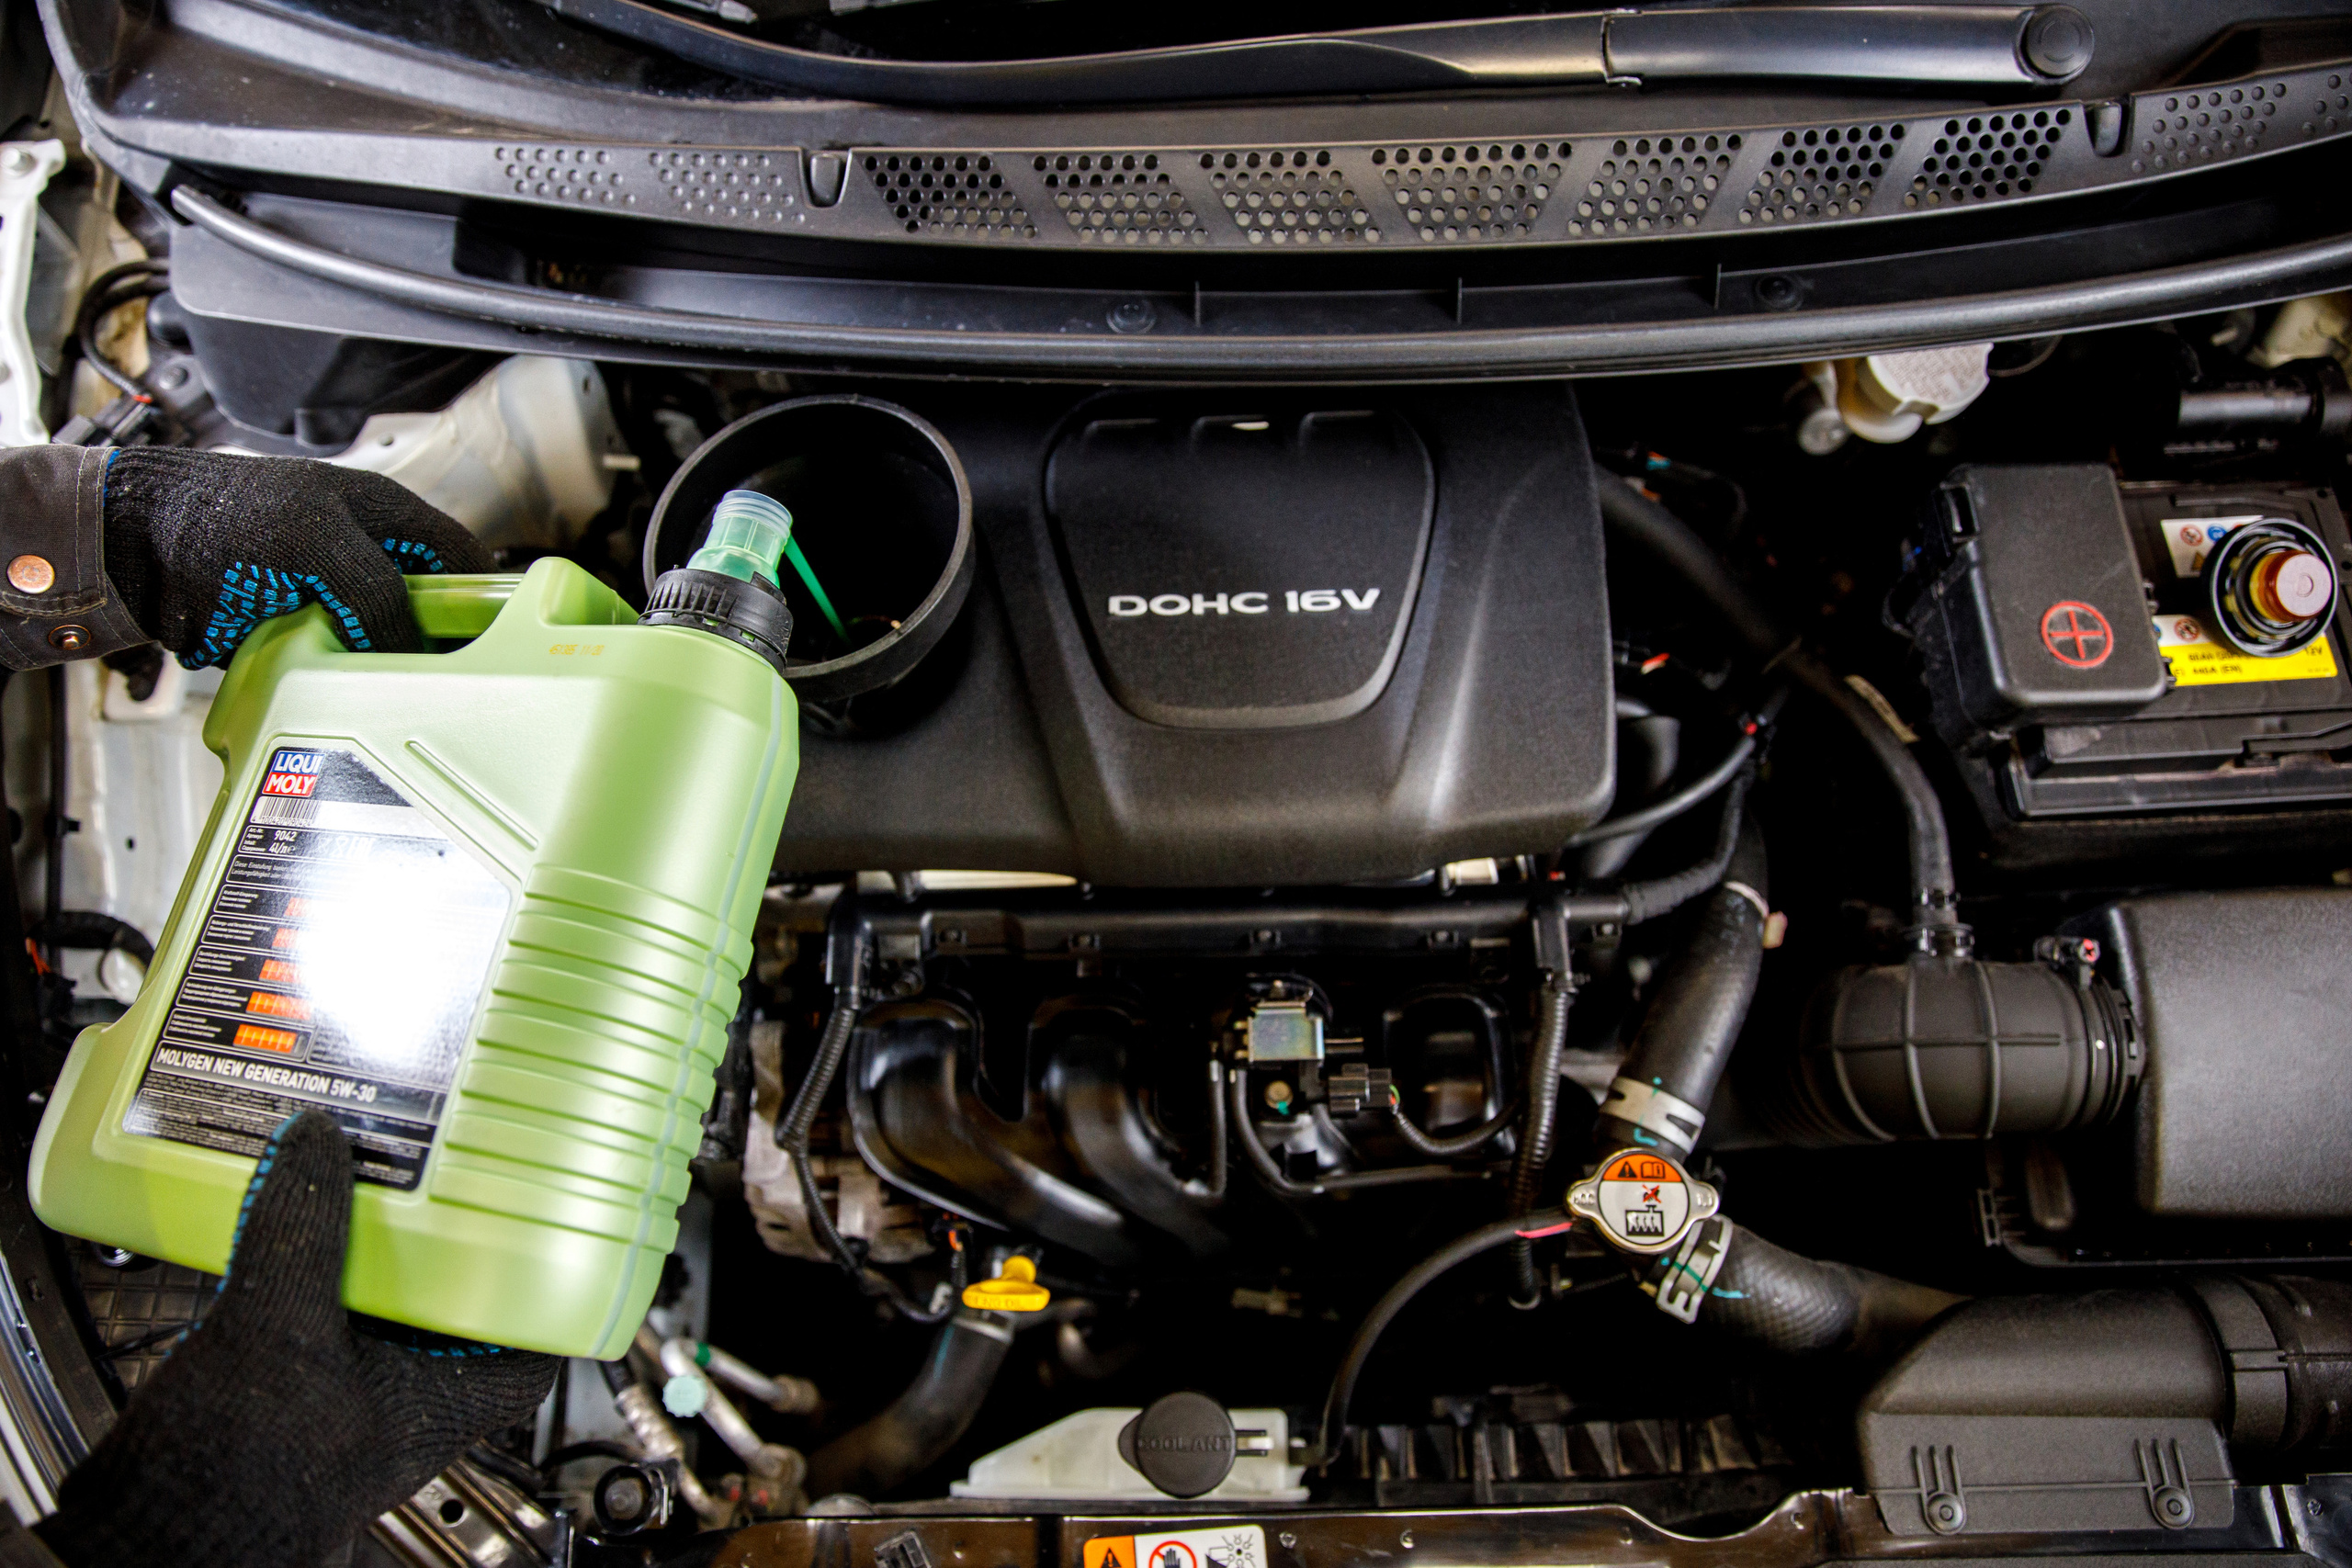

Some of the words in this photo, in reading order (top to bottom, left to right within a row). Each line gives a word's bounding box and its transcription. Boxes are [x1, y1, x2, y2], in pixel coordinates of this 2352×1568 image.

[1107, 591, 1269, 616] DOHC
[1284, 588, 1380, 613] 16V
[274, 753, 324, 774] LIQUI
[266, 774, 317, 795] MOLY
[274, 829, 298, 841] 9042
[156, 1048, 213, 1072] MOLYGEN
[212, 1057, 244, 1077] NEW
[244, 1063, 329, 1093] GENERATION
[330, 1077, 378, 1103] 5W-30
